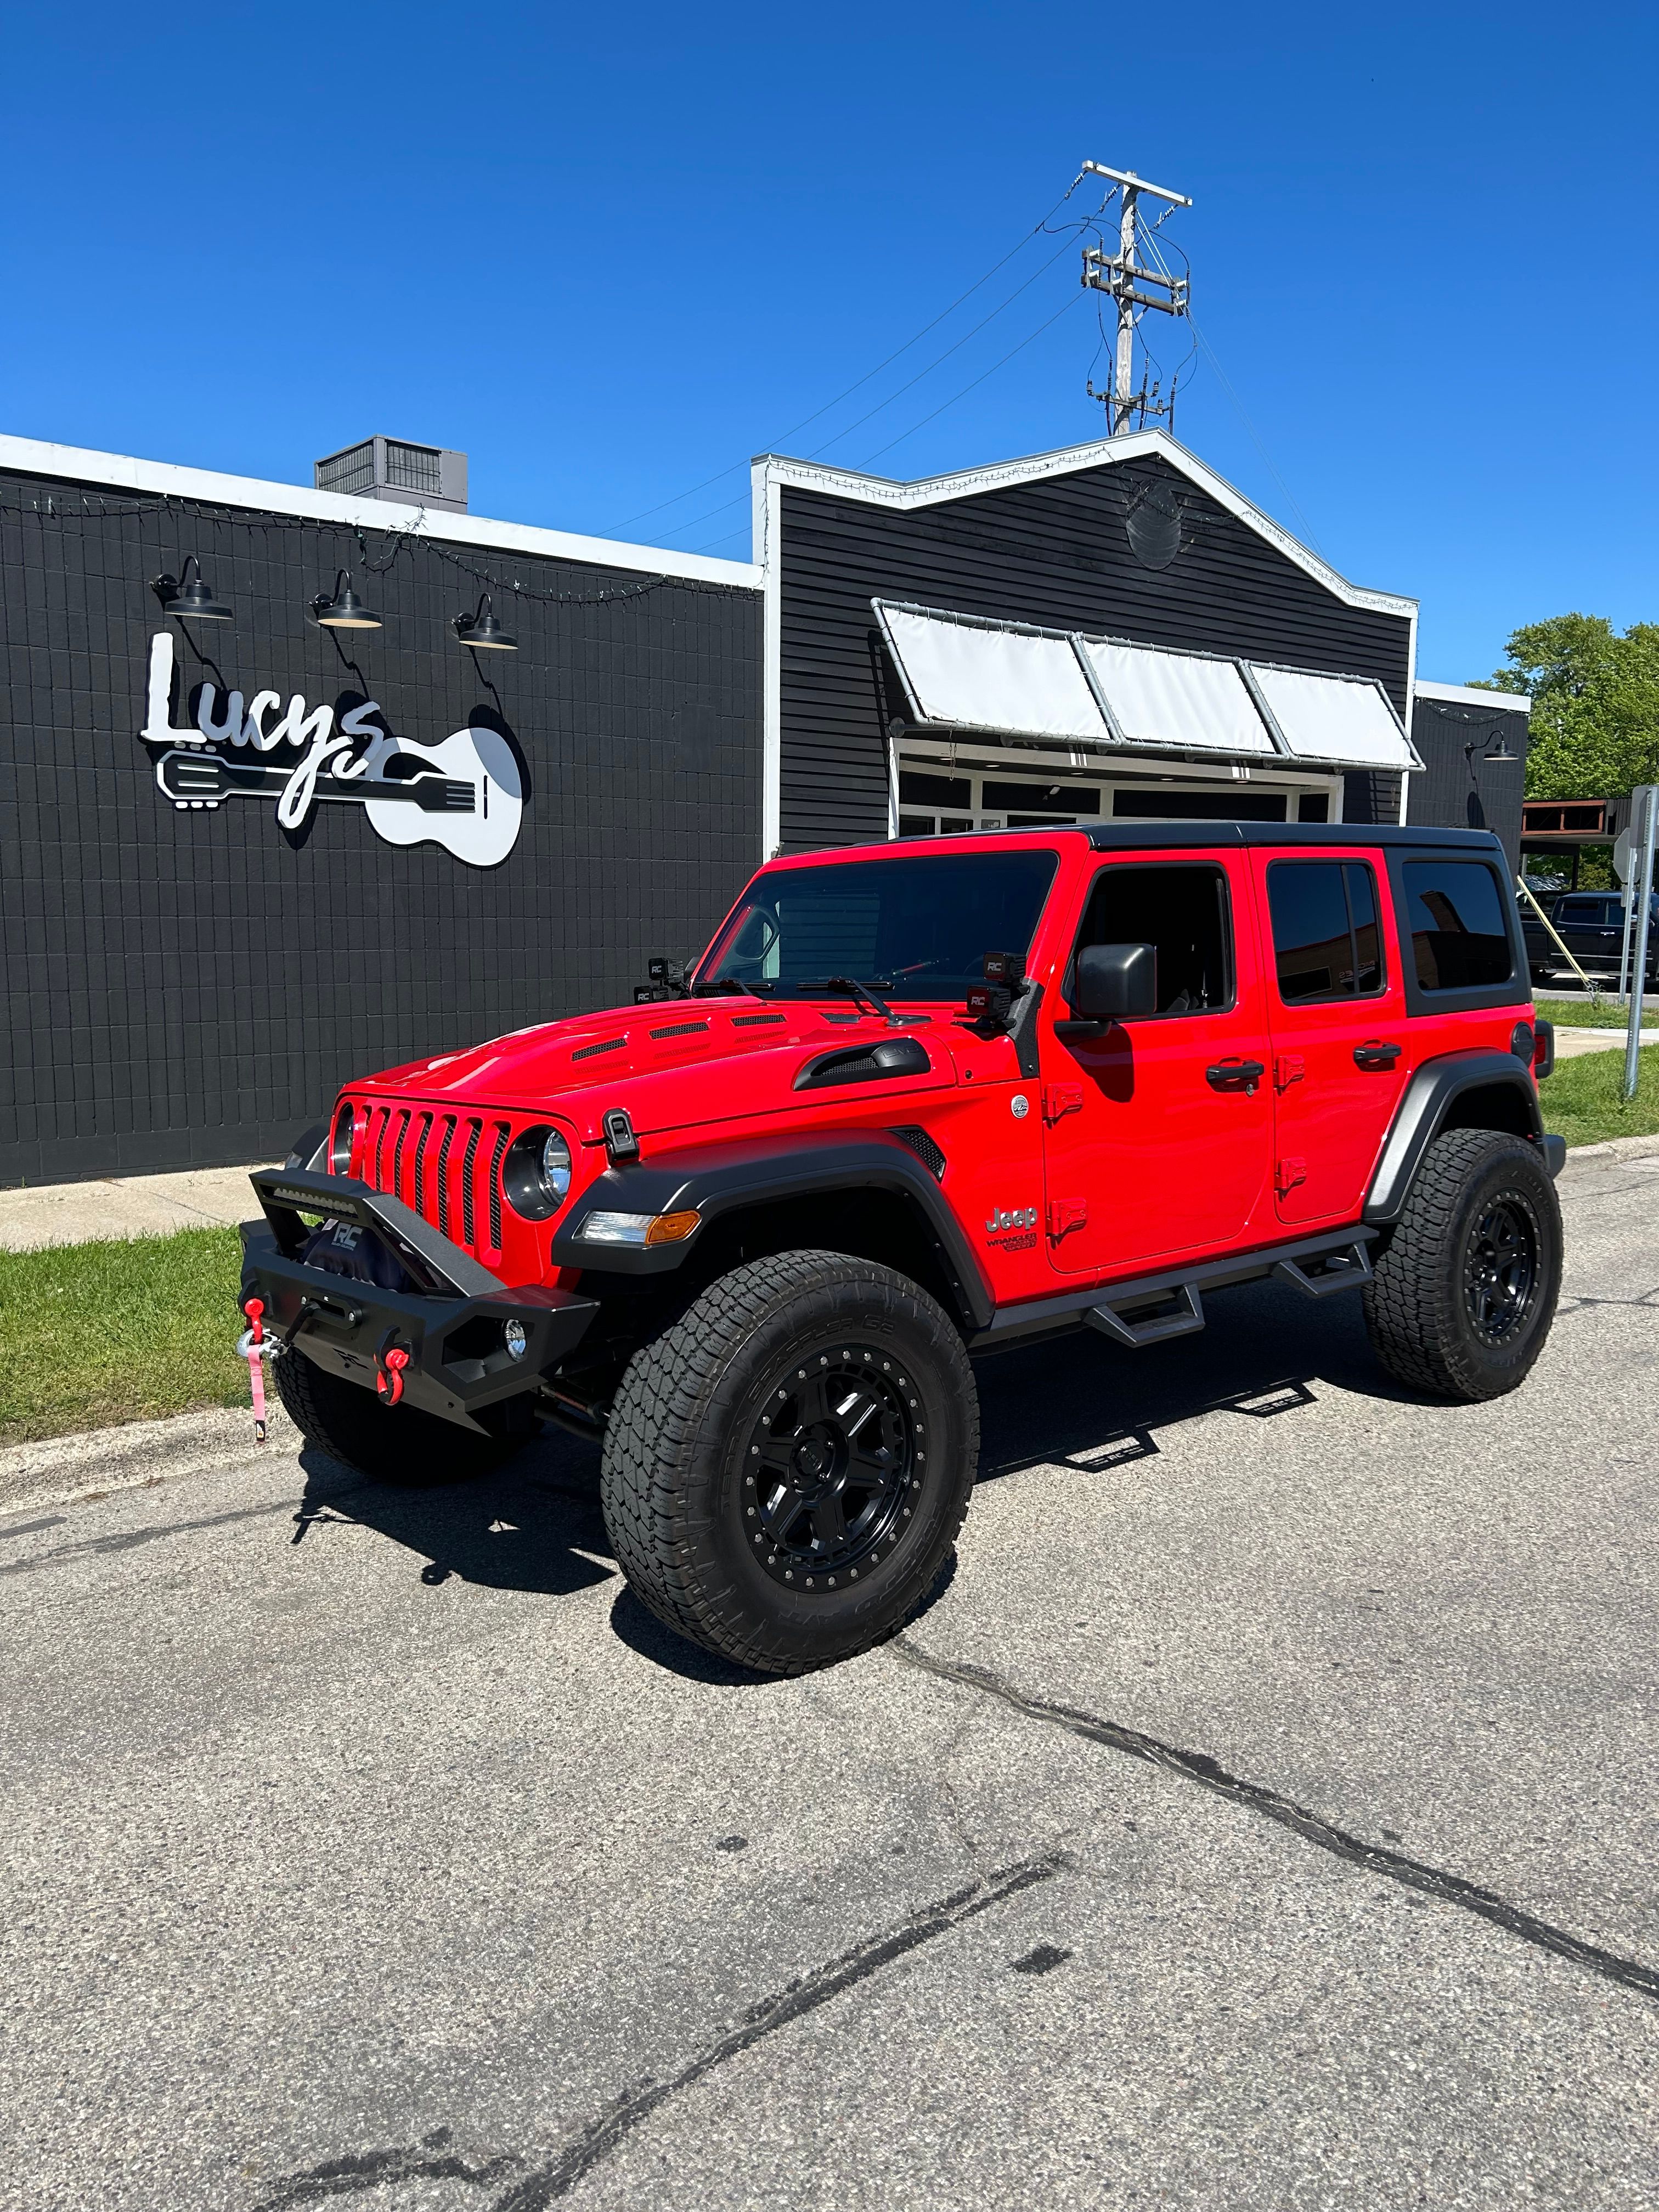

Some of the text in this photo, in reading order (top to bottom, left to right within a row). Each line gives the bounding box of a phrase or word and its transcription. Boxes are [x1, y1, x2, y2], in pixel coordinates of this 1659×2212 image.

[140, 632, 384, 829] Lucys
[988, 962, 1002, 971] RC
[971, 996, 985, 1005] RC
[985, 1207, 1037, 1232] Jeep
[333, 1223, 363, 1248] RC
[986, 1232, 1037, 1246] WRANGLER
